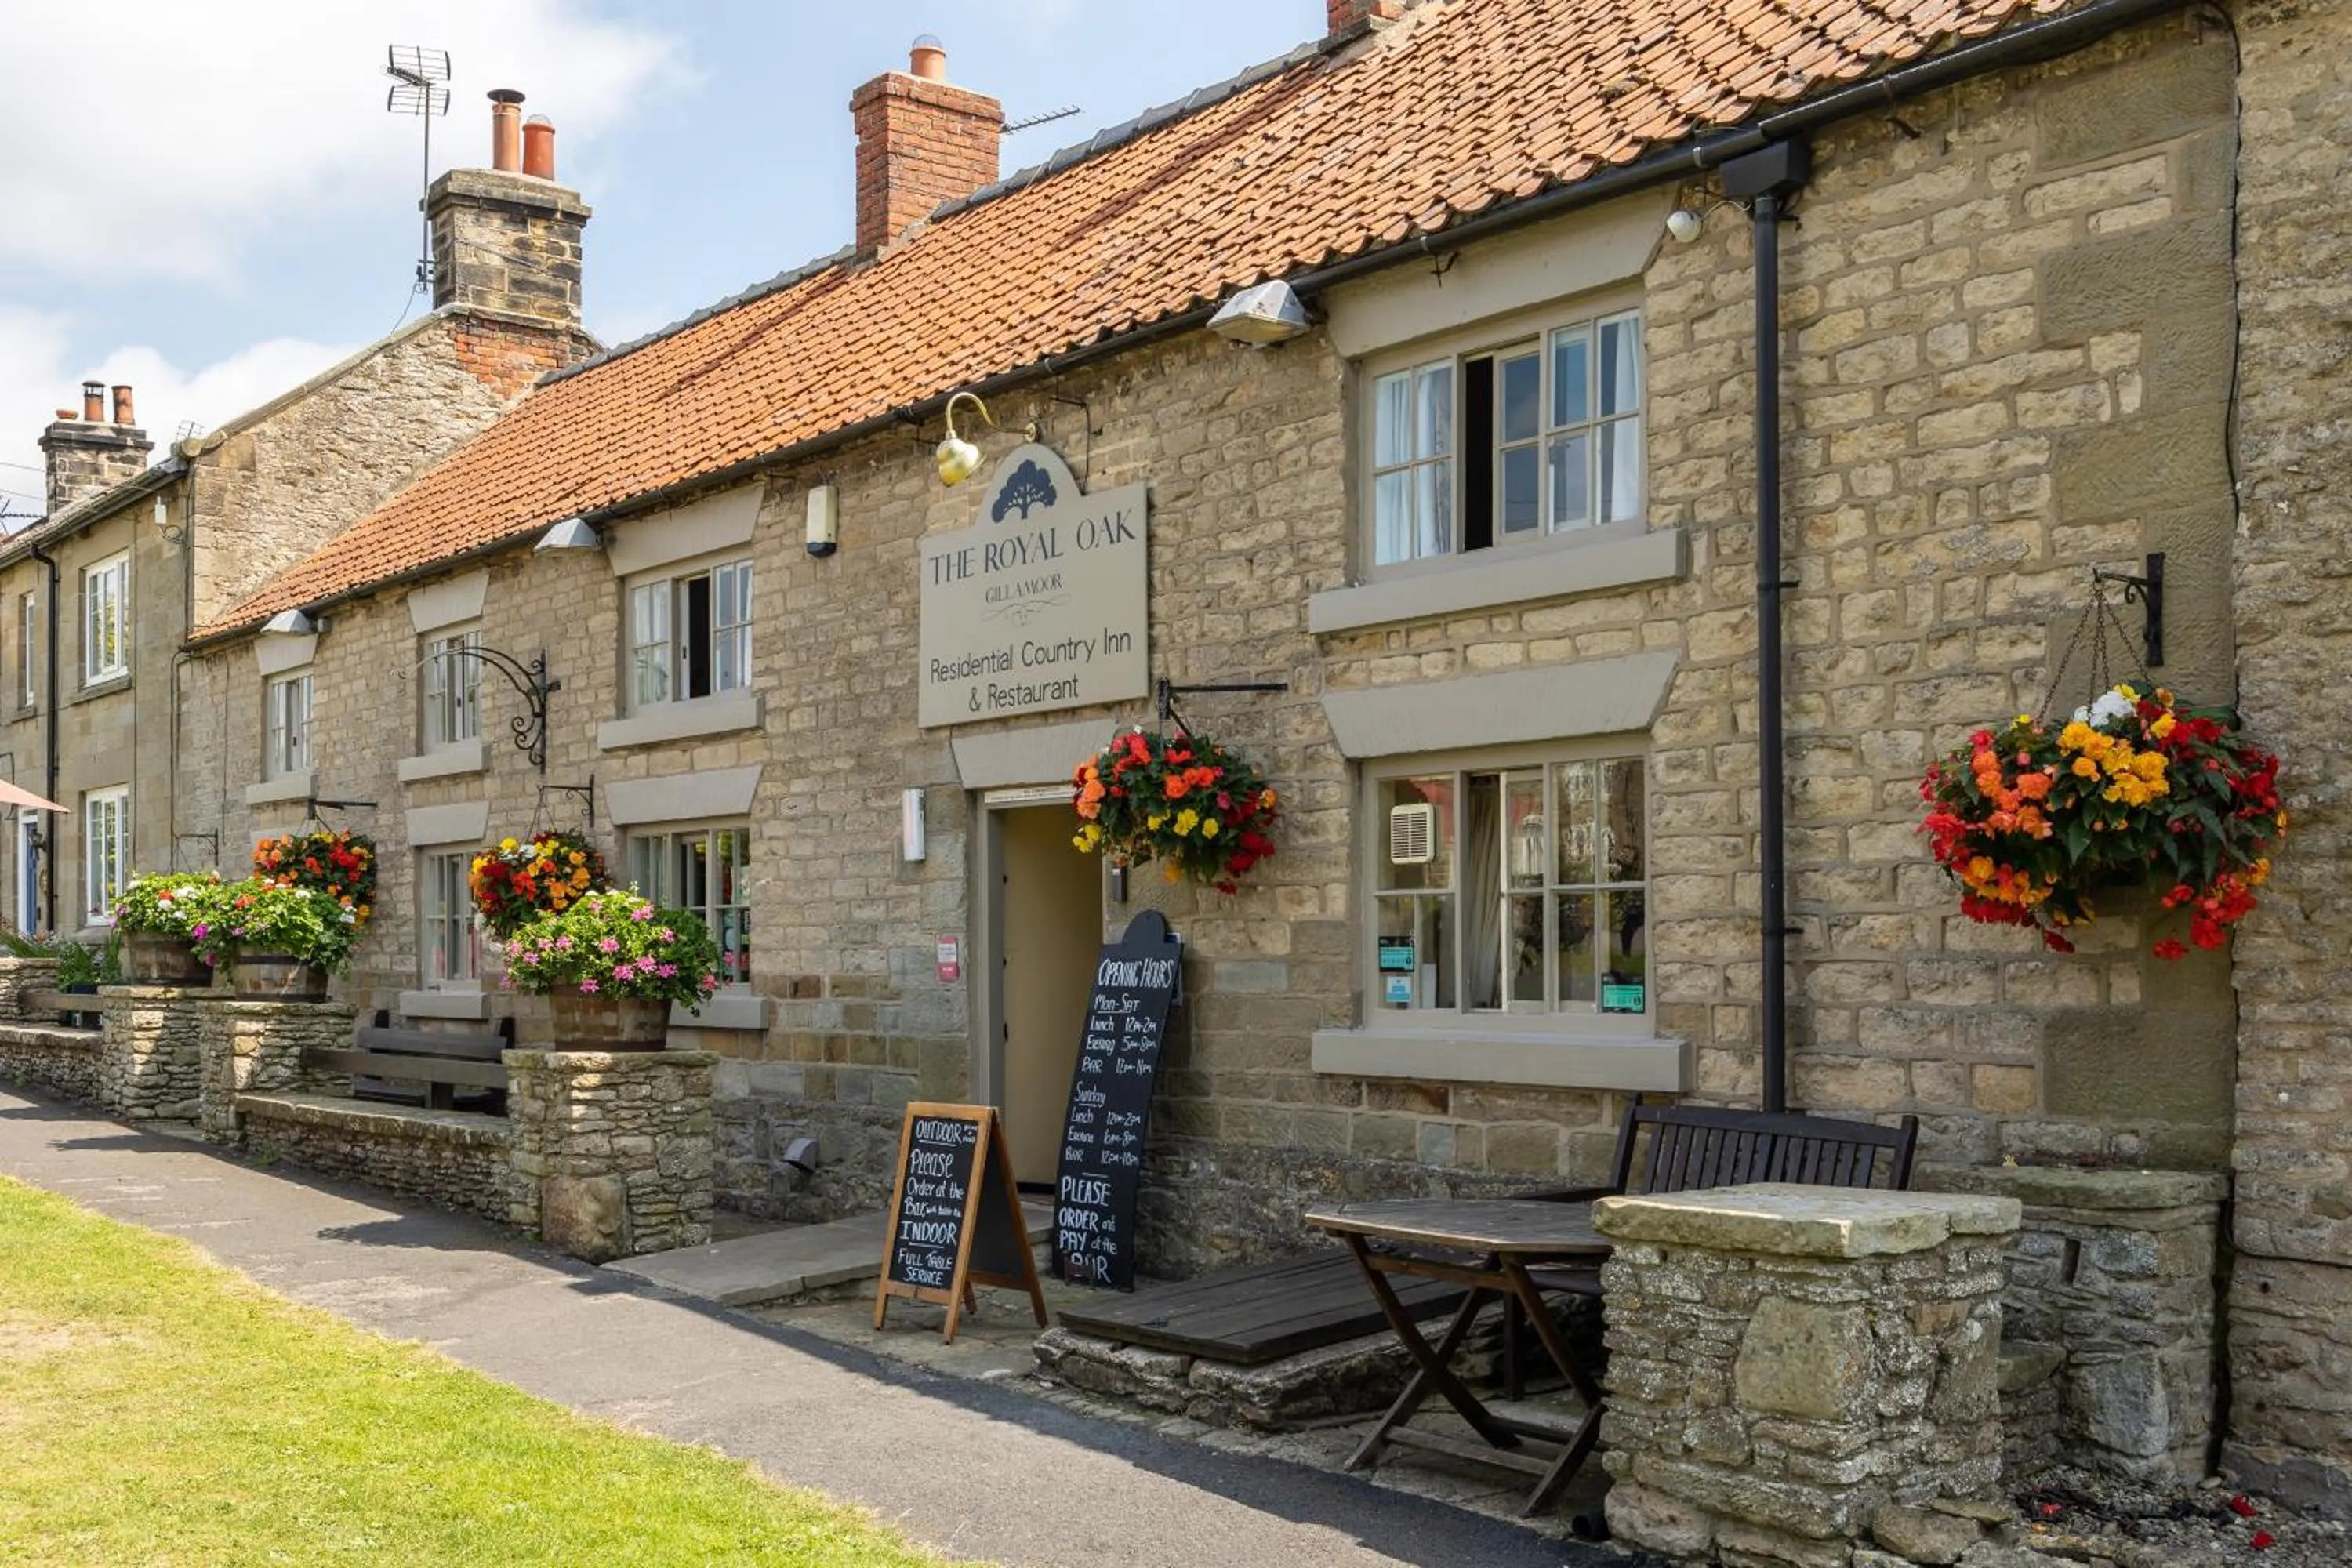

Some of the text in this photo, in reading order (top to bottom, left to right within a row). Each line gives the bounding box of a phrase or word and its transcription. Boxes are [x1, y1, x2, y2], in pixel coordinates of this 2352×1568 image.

[928, 507, 1137, 586] THE ROYAL OAK
[985, 572, 1064, 604] GILLAMOOR
[930, 626, 1131, 684] Residential Country Inn
[967, 673, 1080, 712] & Restaurant
[1098, 957, 1174, 989] OPENING HOURS
[1090, 1015, 1114, 1033] Lunch
[1074, 1081, 1106, 1108] Sunday
[1070, 1106, 1094, 1123] Lunch
[916, 1120, 962, 1145] OUTDOOR
[907, 1177, 965, 1200] Order at the
[1061, 1174, 1112, 1207] PLEASE
[1058, 1207, 1116, 1233] ORDER and
[899, 1220, 958, 1247] INDOOR
[1059, 1230, 1118, 1255] PAY at the
[898, 1247, 953, 1270] FULL TABLE
[902, 1266, 944, 1286] SERVICE
